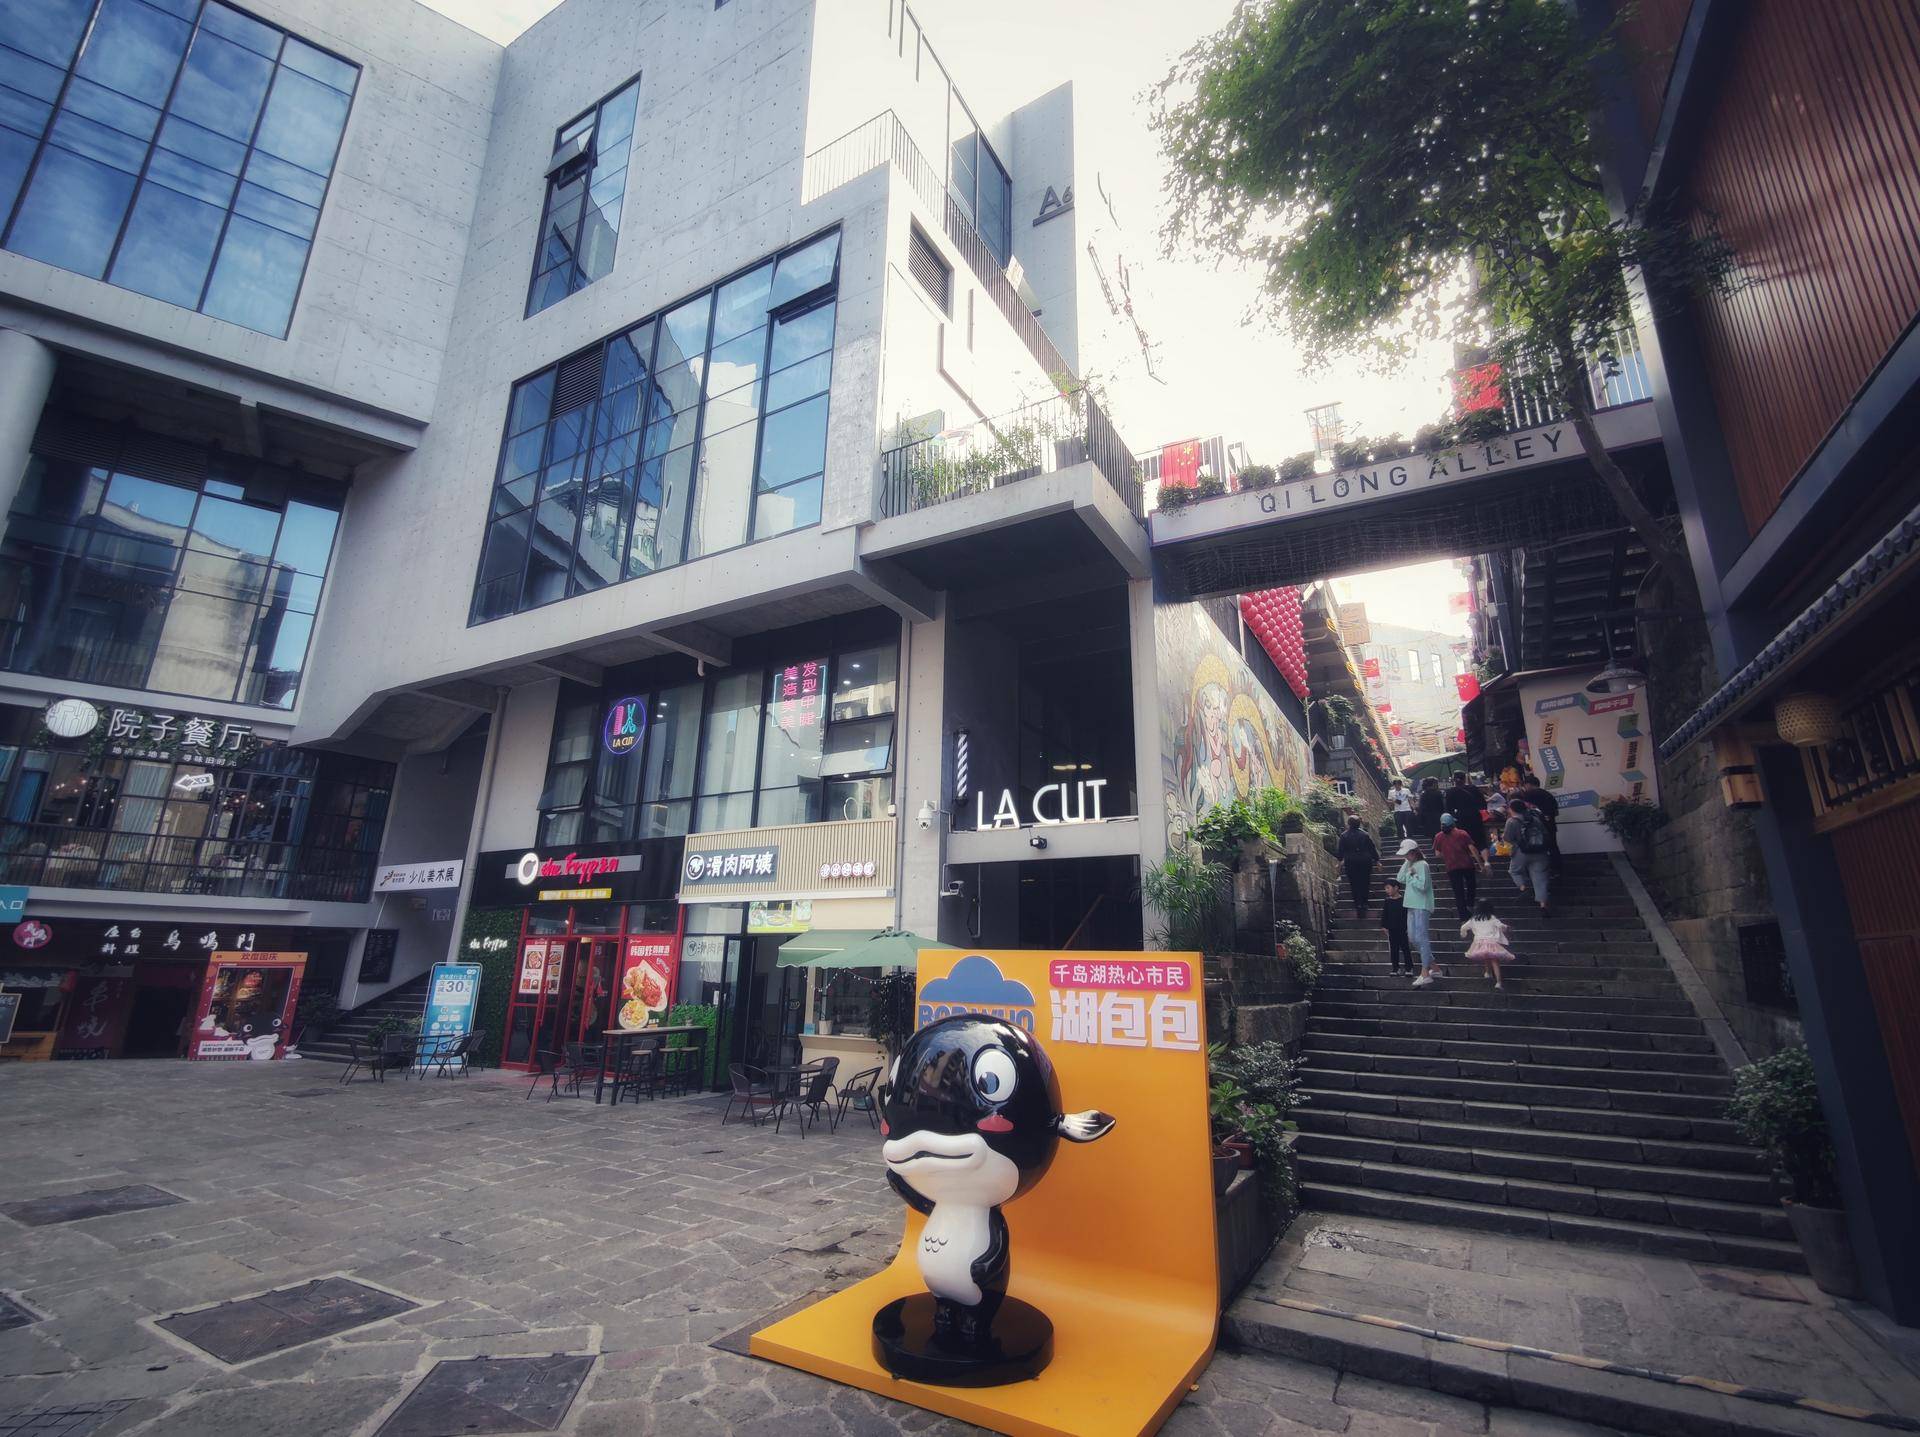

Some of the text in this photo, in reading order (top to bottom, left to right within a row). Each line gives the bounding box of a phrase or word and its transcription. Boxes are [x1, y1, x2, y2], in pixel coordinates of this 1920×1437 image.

[1040, 185, 1073, 215] A6
[1260, 429, 1562, 514] QI LONG ALLEY
[108, 708, 252, 751] 院子餐厅
[612, 736, 634, 748] LA CUT
[1543, 722, 1554, 746] ALLEY
[977, 779, 1107, 830] LA CUT
[706, 851, 774, 877] 滑肉阿姨
[1053, 964, 1184, 986] 千岛湖热心市民
[1050, 990, 1200, 1050] 湖包包
